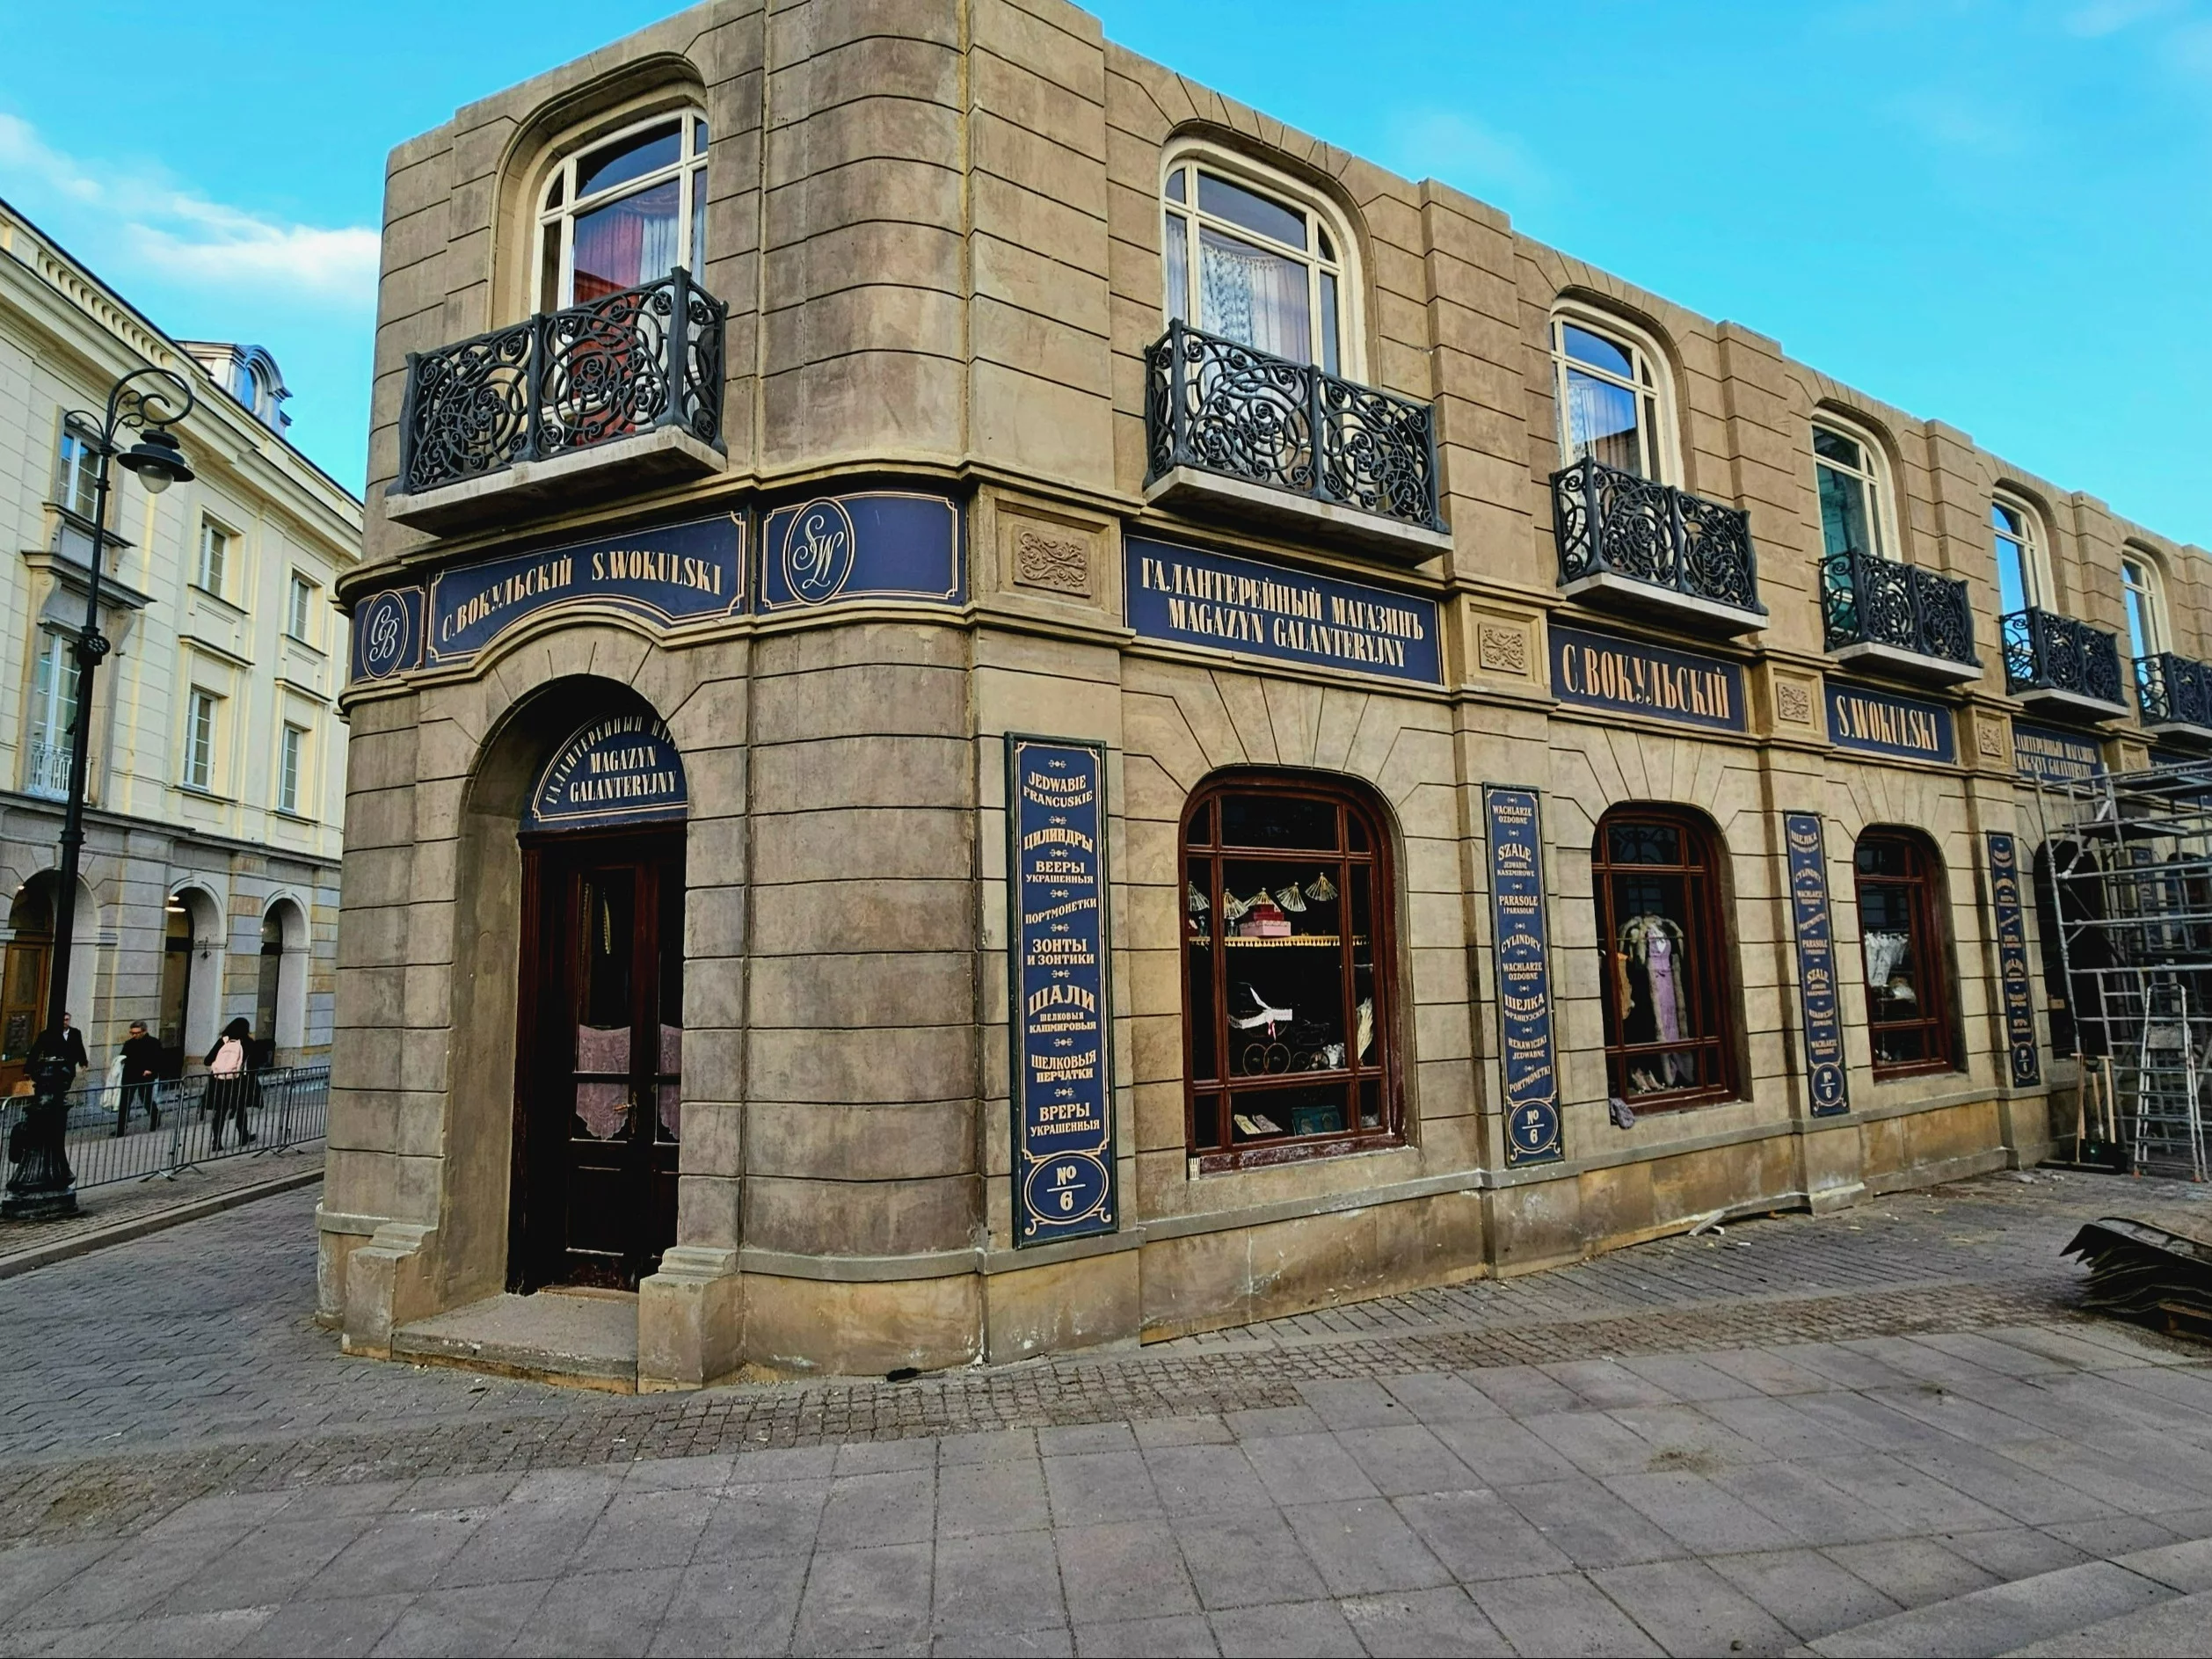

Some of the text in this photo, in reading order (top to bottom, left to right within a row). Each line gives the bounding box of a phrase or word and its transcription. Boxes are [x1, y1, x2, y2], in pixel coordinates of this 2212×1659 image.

[1141, 557, 1424, 640] ГАЛАНТЕРЕЙНЫЙ МАГАЗИНЪ
[1168, 598, 1405, 667] MAGAZYN GALANTERYJNY
[590, 746, 657, 774] MAGAZYN
[570, 770, 677, 803] GALANTERYJNY
[1029, 771, 1087, 792] JEDWABIE
[1492, 804, 1532, 817] WACHLARZE
[1498, 816, 1528, 825] OZDOBNE
[1023, 827, 1094, 854] ЦИЛИНДРЫ
[1498, 843, 1532, 862] SZALE
[1036, 861, 1085, 874] ВЕЕРЫ
[1026, 874, 1094, 884] УКРАШЕННЫЯ
[1499, 895, 1538, 906] PARASOLE
[1025, 898, 1097, 924] ПОРТМОНЕТКИ
[1032, 938, 1087, 953] ЗОНТЫ
[1501, 934, 1541, 953] CYLINDRY
[1027, 953, 1095, 965] И ЗОНТИКИ
[1503, 962, 1542, 971] WACHLARZE
[1509, 971, 1538, 980] OZDOBNE
[1029, 985, 1095, 1016] ШАЛИ
[1504, 993, 1545, 1011] ШЕЛКА
[1040, 1012, 1084, 1022] ШЕЛКОВЫЯ
[1030, 1021, 1096, 1033] КАШМИРОВЫЯ
[1031, 1049, 1096, 1070] ШЕЛКОВЫЯ
[1037, 1067, 1093, 1083] ПЕРЧАТКИ
[1030, 1119, 1100, 1137] УКРАШЕННЫЯ
[1530, 1129, 1538, 1143] 6
[1059, 1190, 1073, 1211] 6
